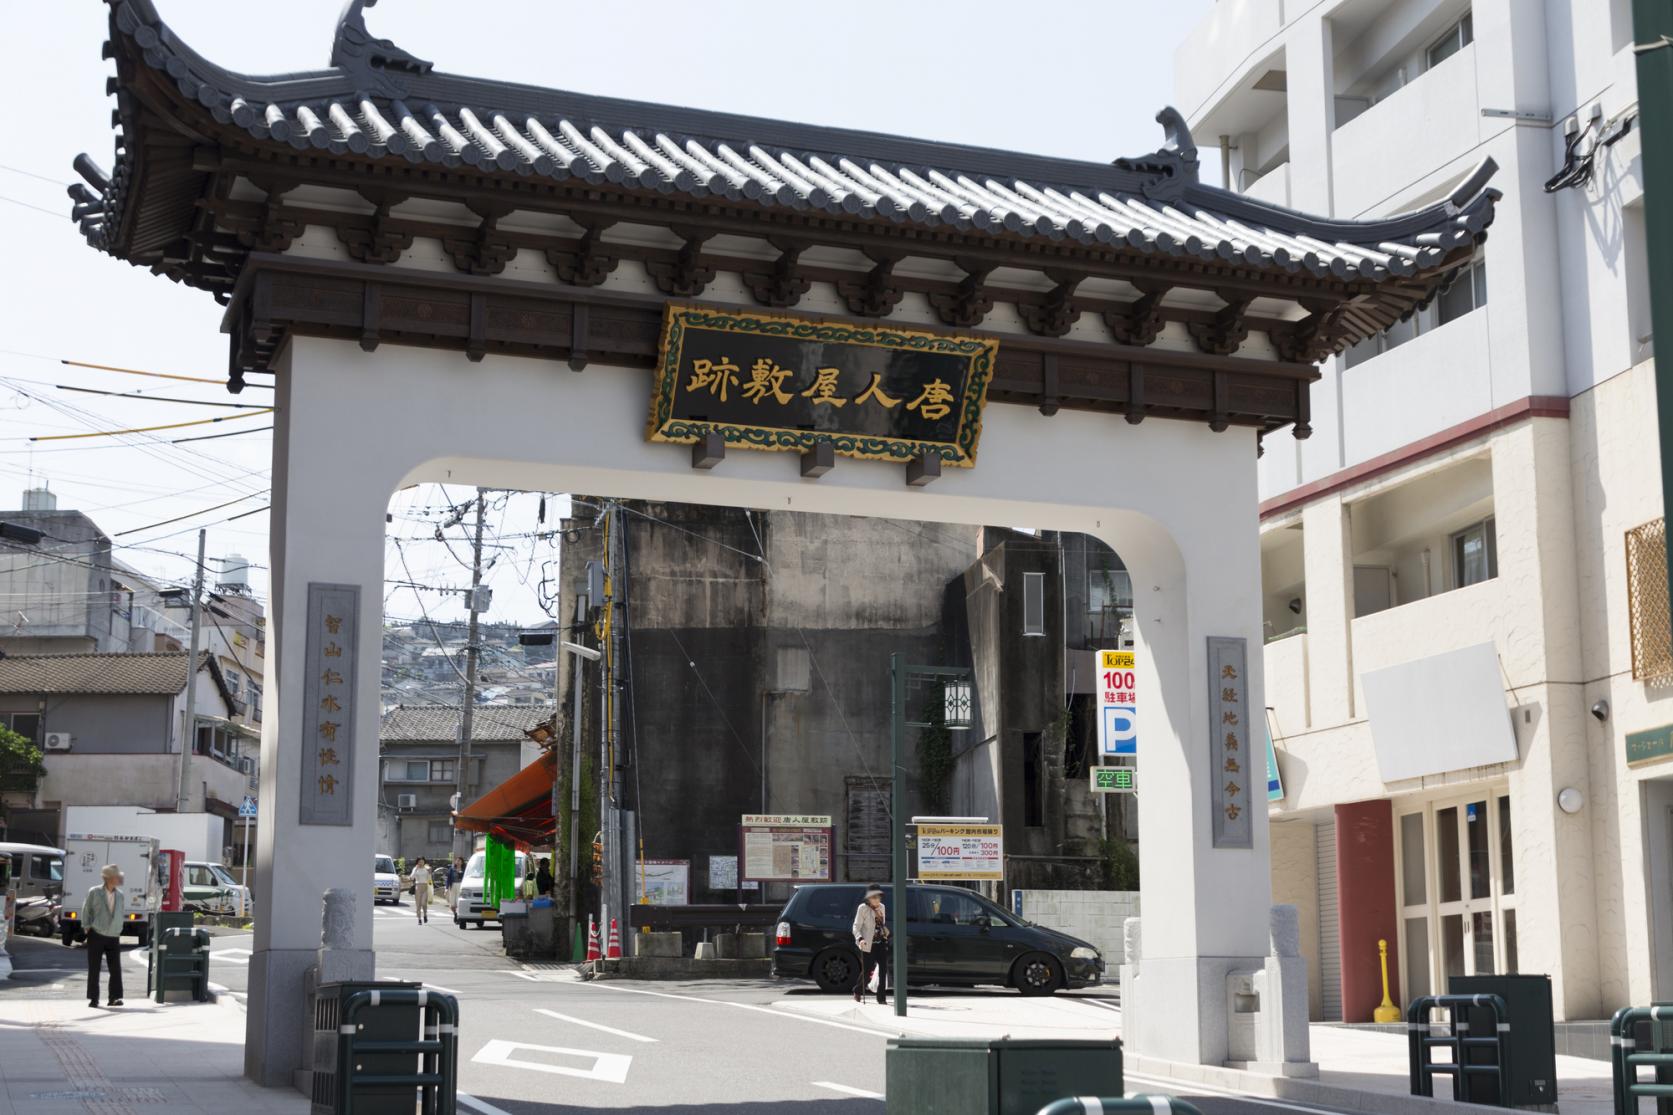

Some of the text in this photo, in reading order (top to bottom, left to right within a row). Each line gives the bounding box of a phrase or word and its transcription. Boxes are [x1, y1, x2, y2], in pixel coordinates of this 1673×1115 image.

[685, 356, 954, 420] 唐人屋敷跡
[1096, 769, 1133, 789] 空車
